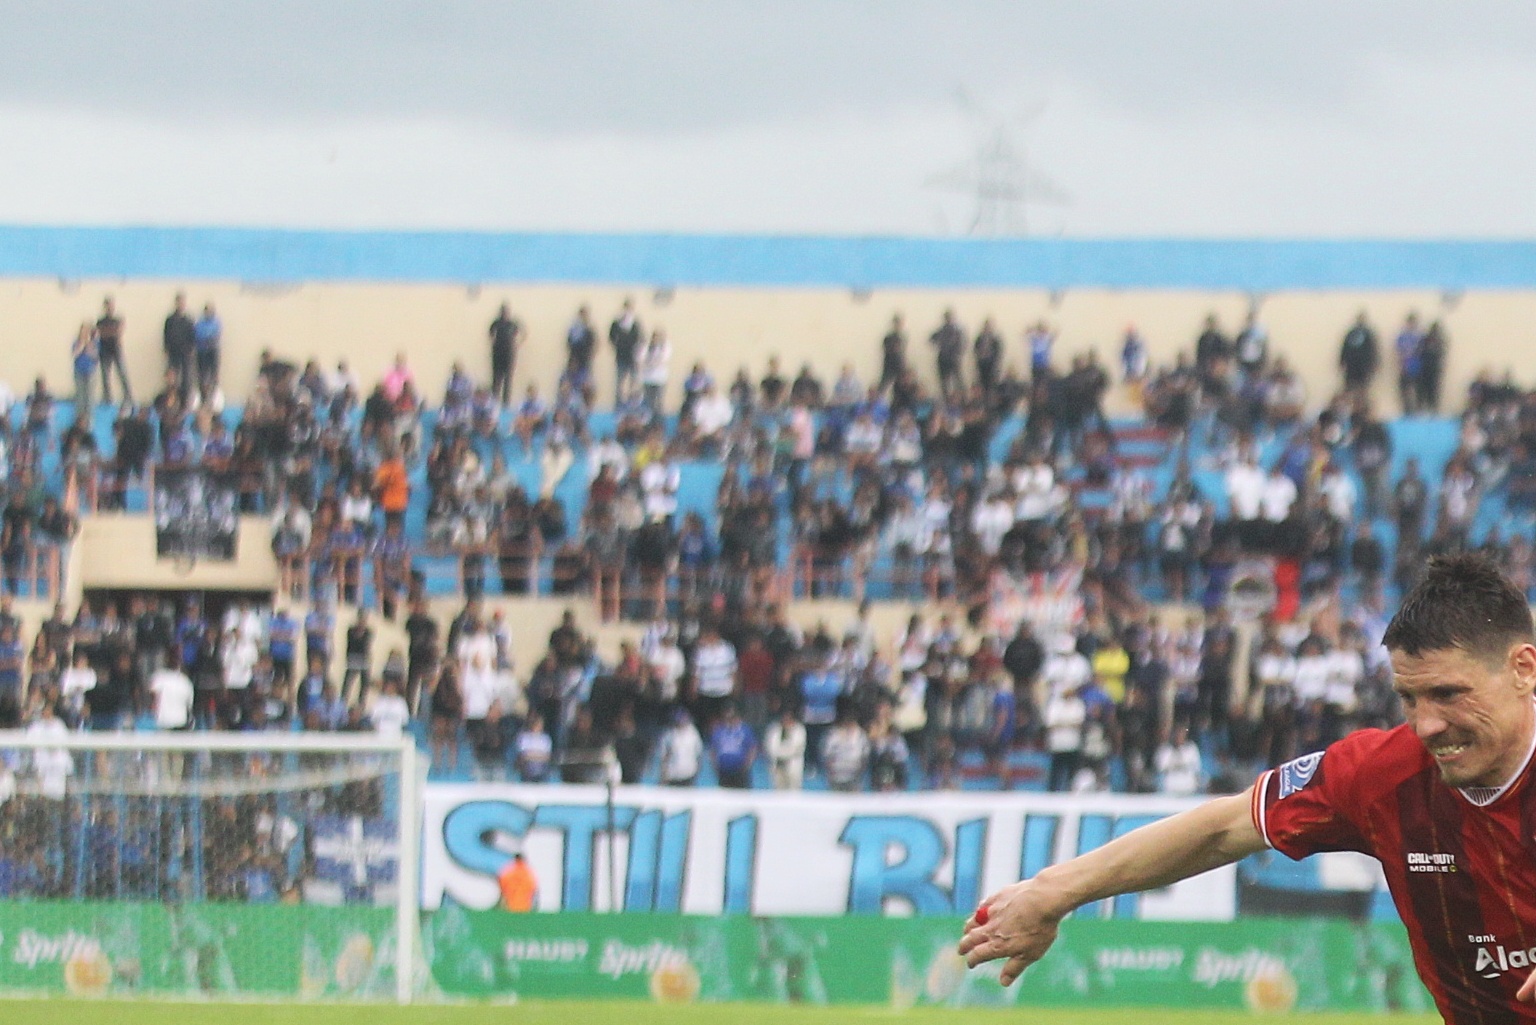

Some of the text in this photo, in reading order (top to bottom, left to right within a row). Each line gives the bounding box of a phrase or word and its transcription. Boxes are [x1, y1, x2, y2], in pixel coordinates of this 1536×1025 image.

[1408, 853, 1431, 864] CALL
[1432, 854, 1455, 865] DUTY
[1409, 865, 1449, 873] MOBILE
[1468, 933, 1497, 943] Bank
